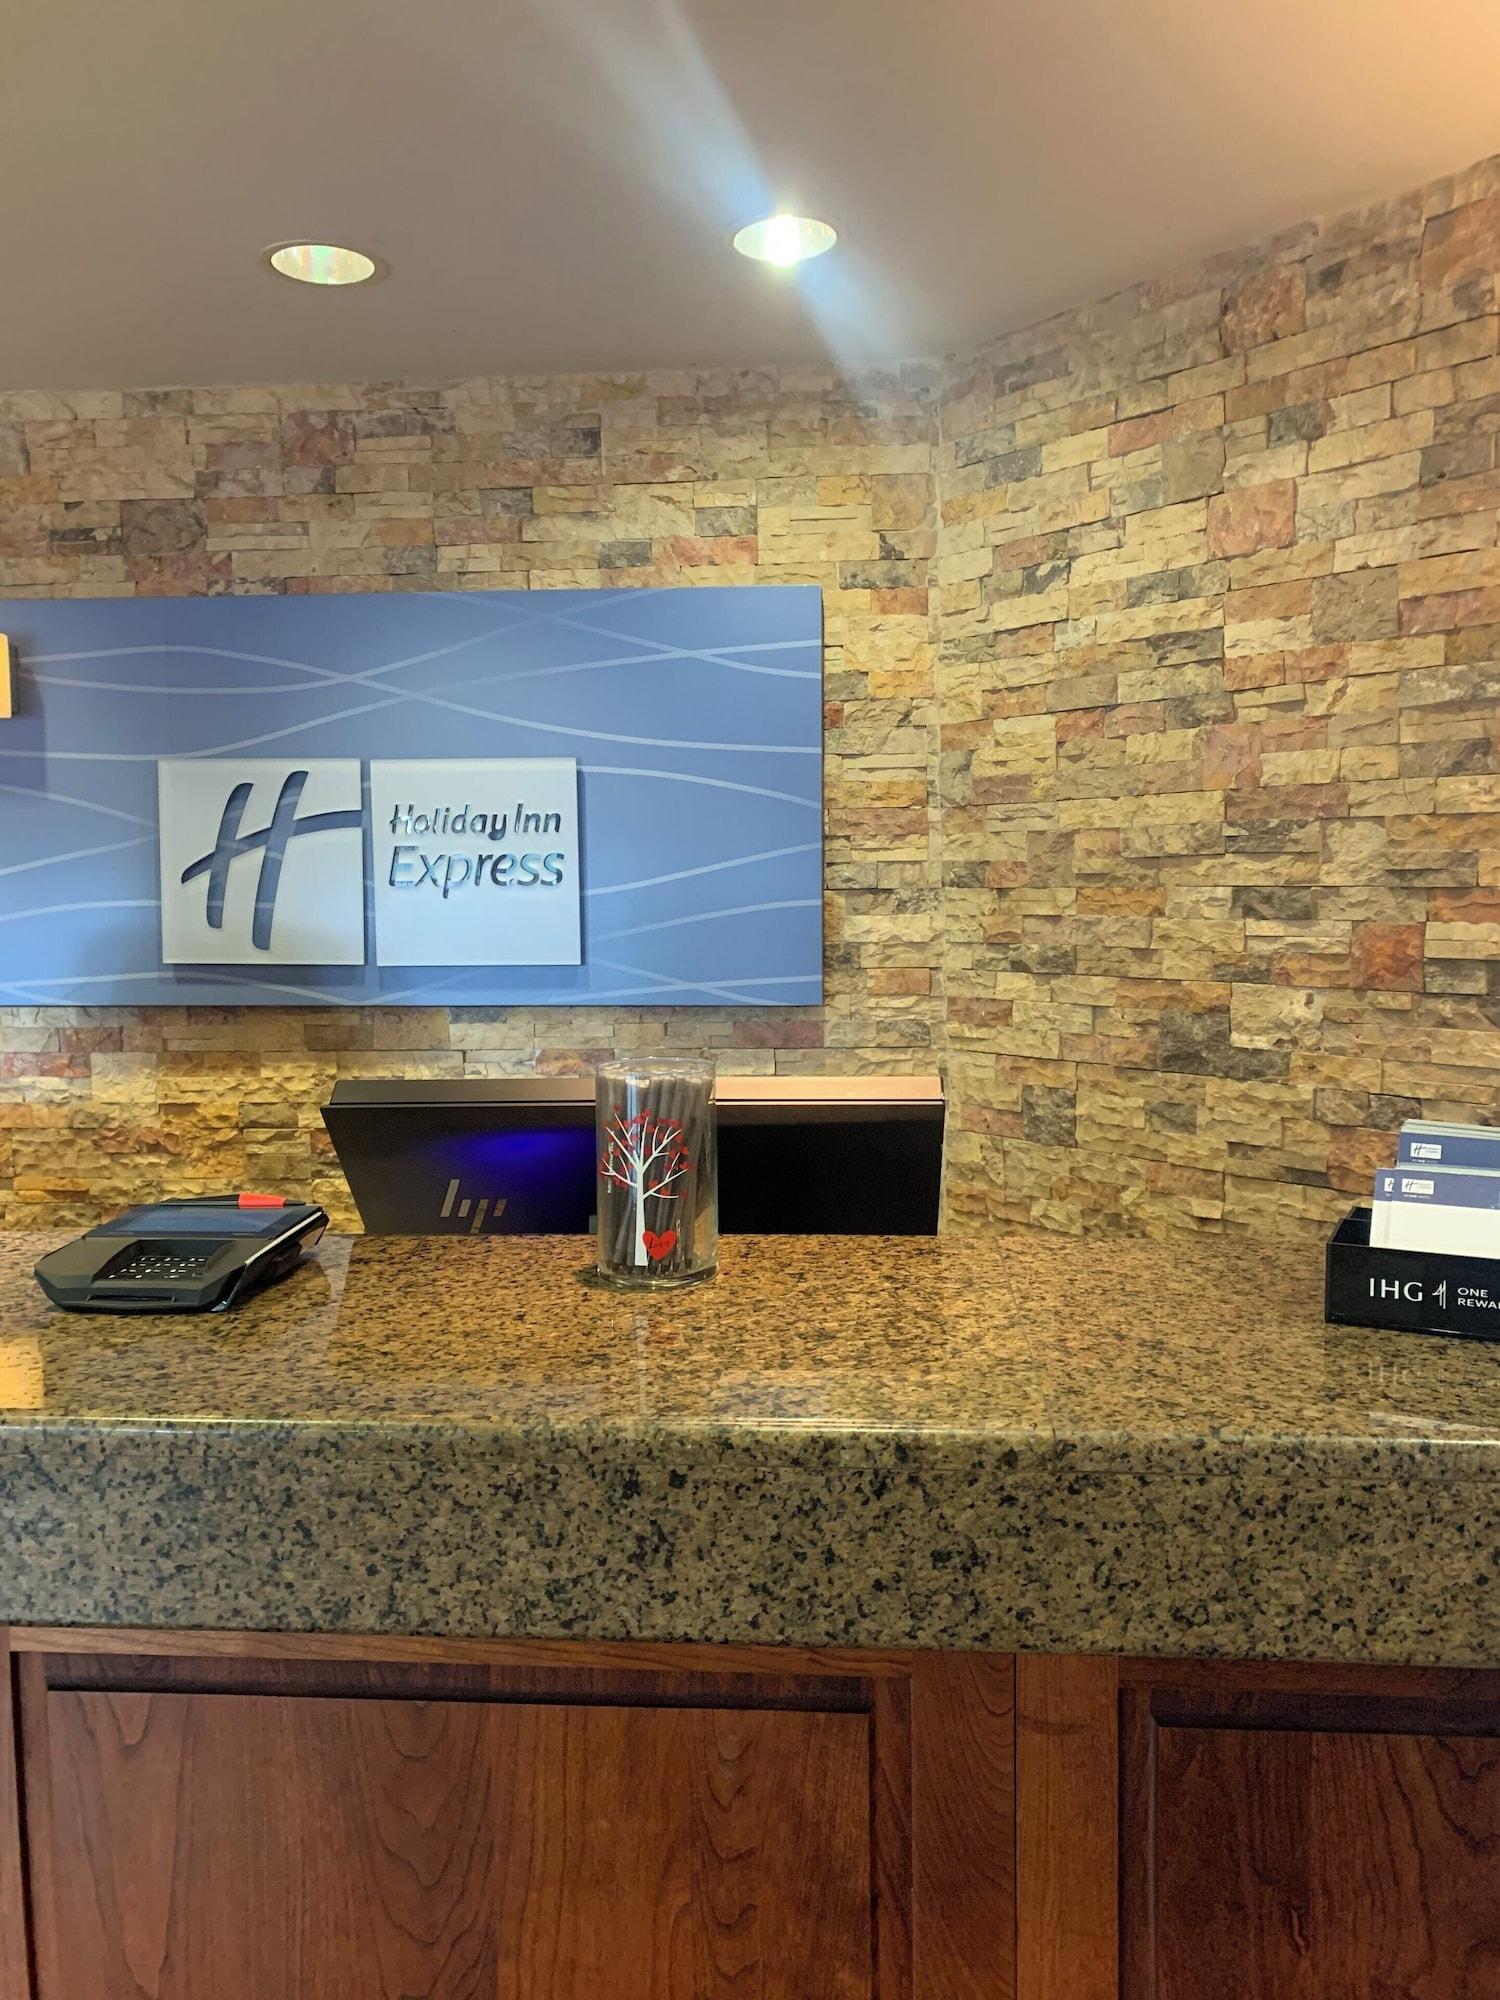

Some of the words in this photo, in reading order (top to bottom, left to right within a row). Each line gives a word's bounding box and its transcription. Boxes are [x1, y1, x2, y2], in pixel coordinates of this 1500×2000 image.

[389, 803, 508, 841] Holiday
[513, 802, 562, 833] Inn
[388, 844, 565, 899] Express
[1369, 1277, 1423, 1302] IHG
[1457, 1286, 1489, 1299] ONE
[1457, 1297, 1500, 1311] REWA
